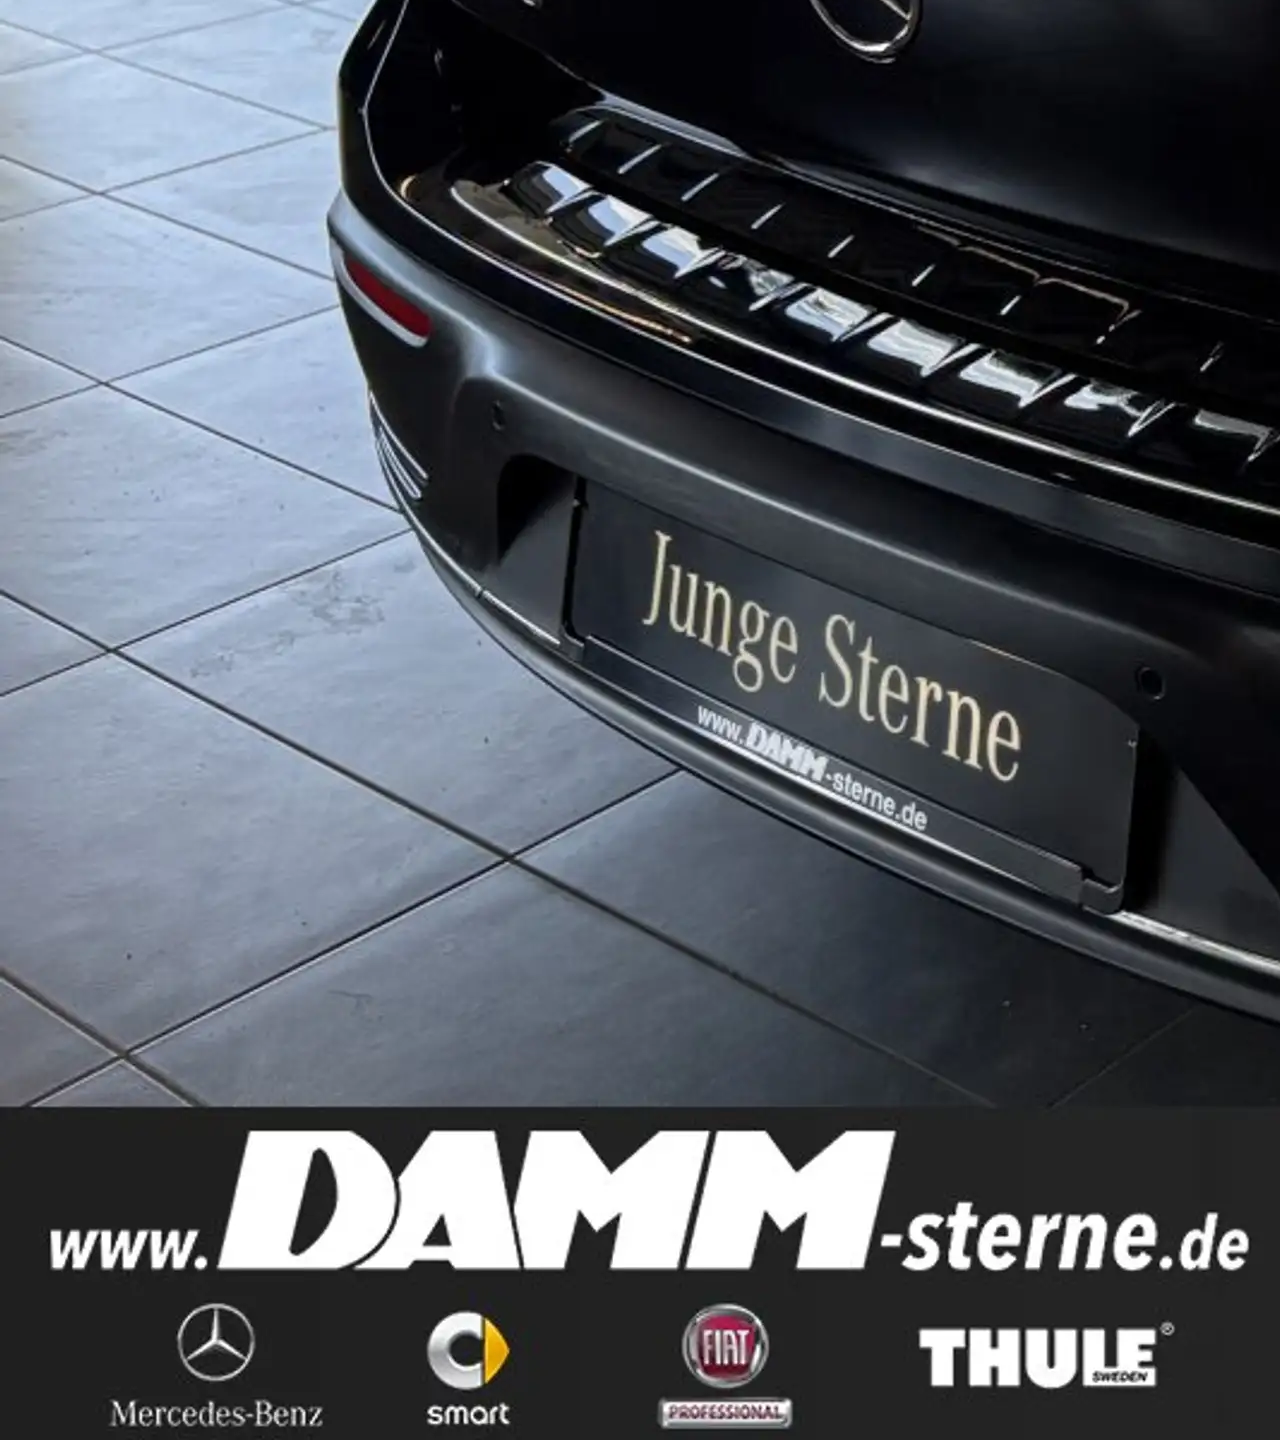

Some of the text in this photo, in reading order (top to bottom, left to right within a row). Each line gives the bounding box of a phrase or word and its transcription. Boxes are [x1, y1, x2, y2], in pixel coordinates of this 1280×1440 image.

[642, 528, 1023, 784] Junge Sterne
[696, 704, 929, 832] www.DAMM-sterne.de
